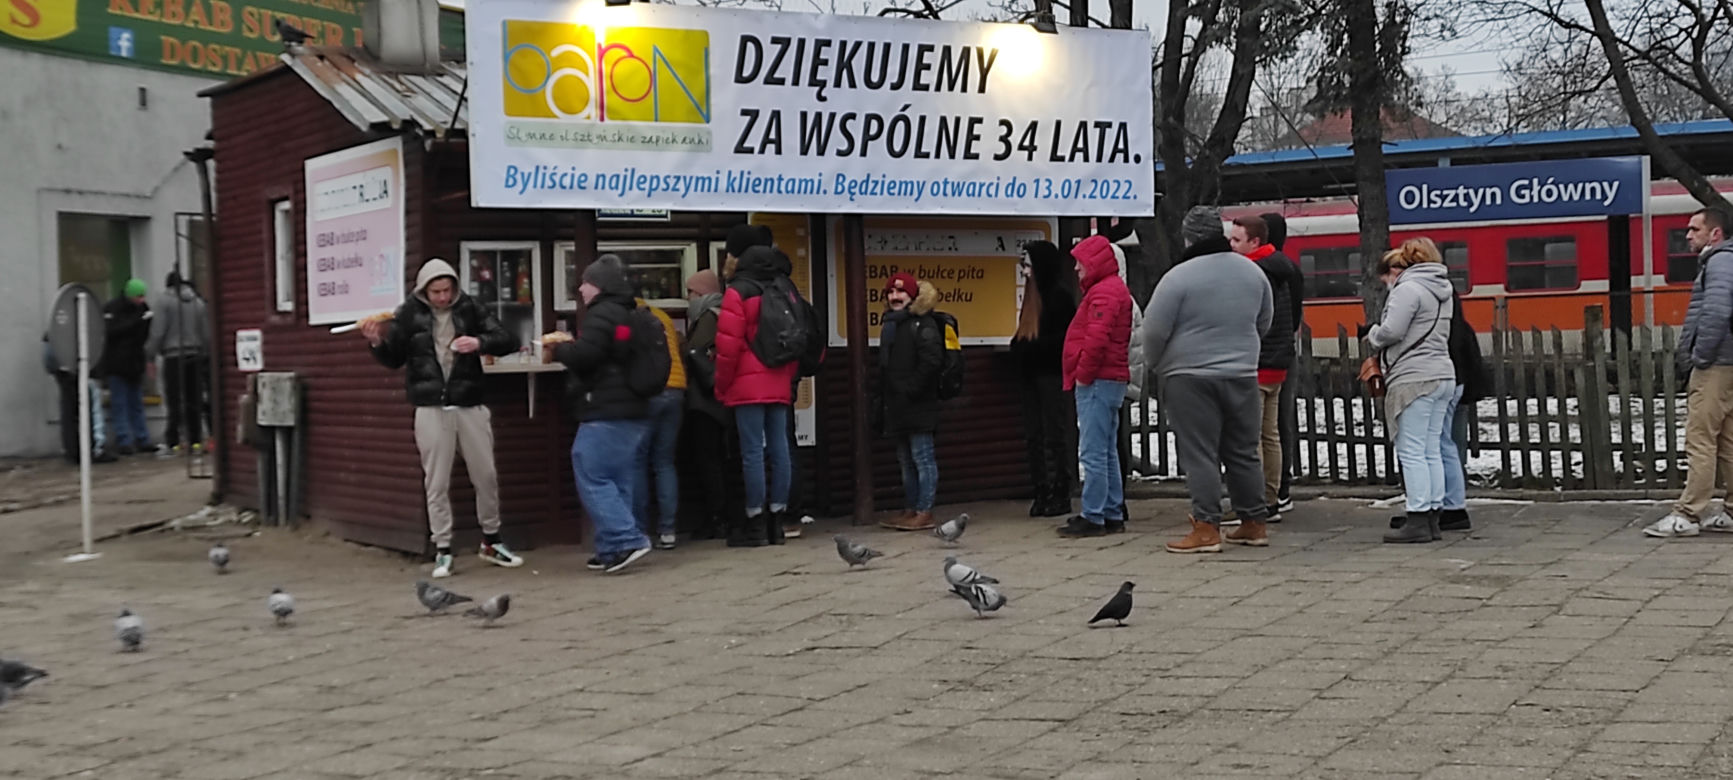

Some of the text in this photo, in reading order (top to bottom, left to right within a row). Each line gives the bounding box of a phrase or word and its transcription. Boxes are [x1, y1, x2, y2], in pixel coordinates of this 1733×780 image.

[733, 34, 999, 102] DZIĘKUJEMY
[733, 104, 1142, 164] ZA WSPÓLNE 34 LATA.
[504, 164, 1139, 202] Byliście najlepszymi klientami. Będziemy otwarci do 13.01.2022.
[1399, 177, 1620, 213] Olsztyn Główny
[918, 264, 955, 280] bułce
[957, 264, 985, 282] pita
